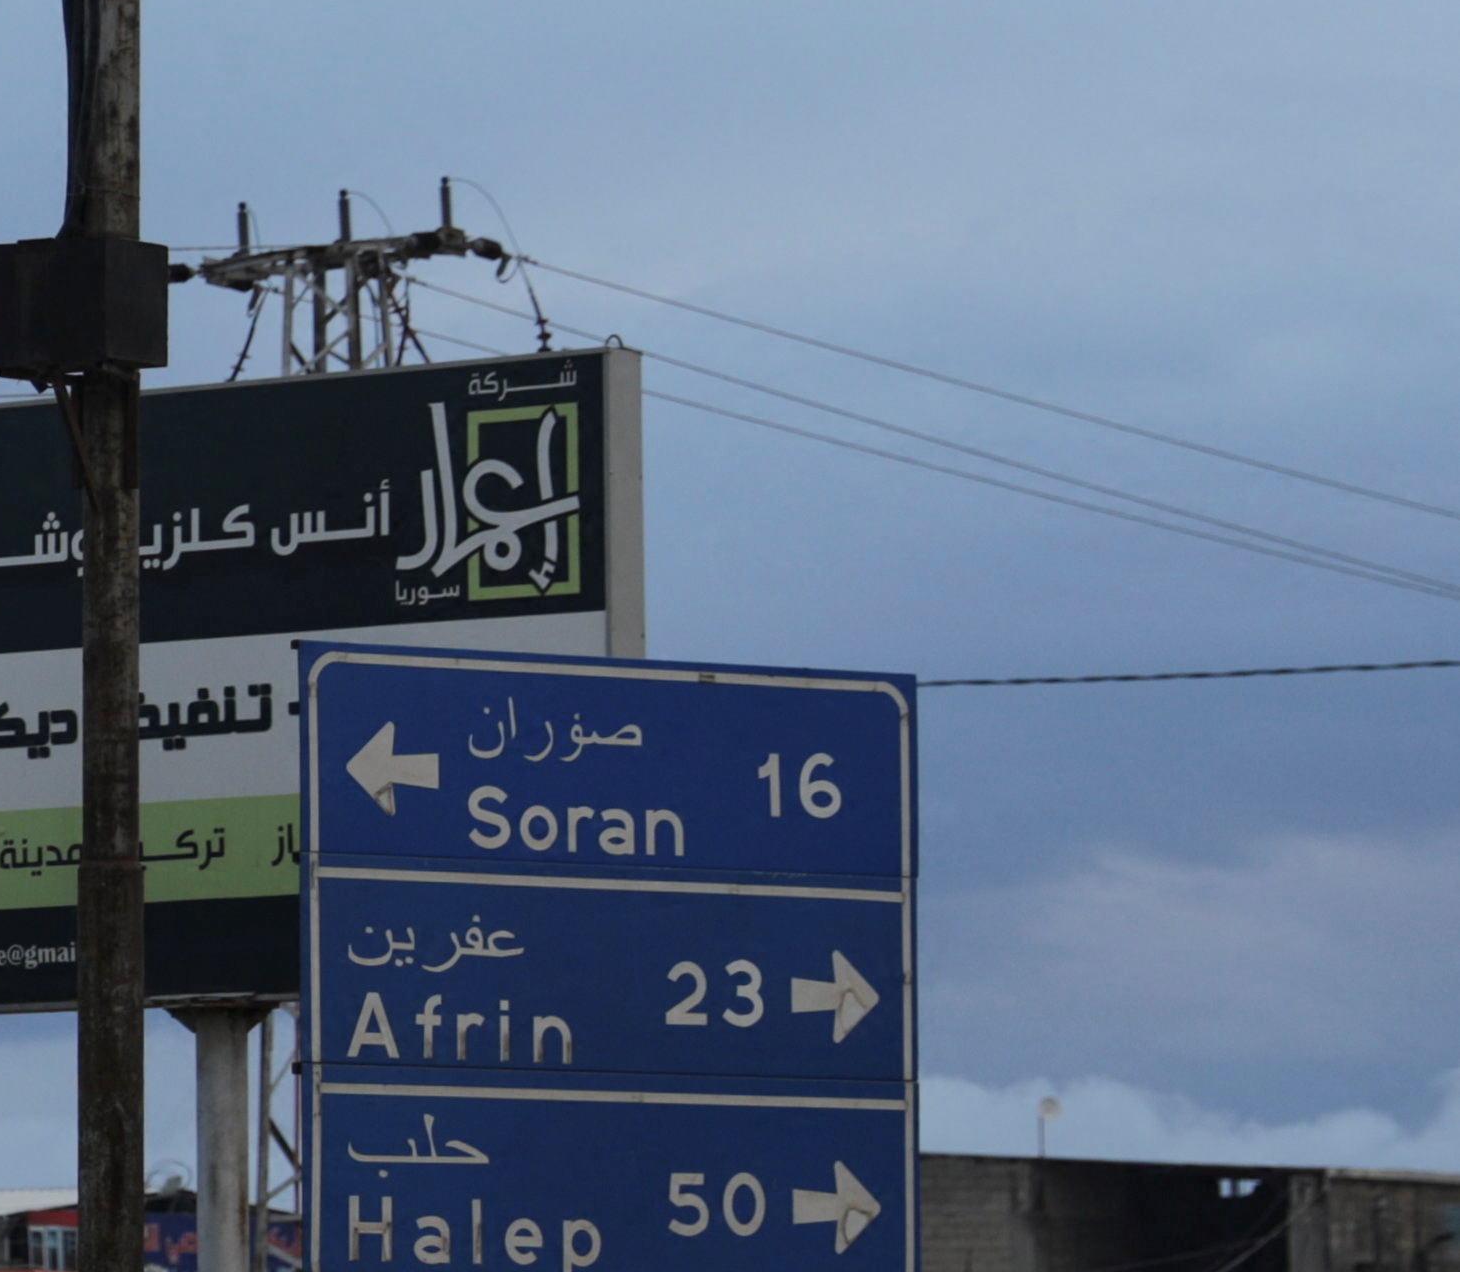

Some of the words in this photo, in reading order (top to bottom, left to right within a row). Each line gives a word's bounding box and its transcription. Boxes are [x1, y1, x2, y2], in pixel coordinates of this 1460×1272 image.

[468, 359, 578, 403] شركة
[138, 503, 256, 570] كلزي
[271, 477, 391, 557] أنس
[394, 581, 462, 606] سوريا
[468, 695, 644, 763] صوران
[467, 785, 686, 858] Soran
[757, 752, 843, 819] 16
[138, 827, 225, 871] تركي
[347, 914, 525, 973] عفرين
[346, 992, 574, 1065] Afrin
[664, 959, 765, 1028] 23
[347, 1113, 490, 1179] حلب
[666, 1172, 767, 1238] 50
